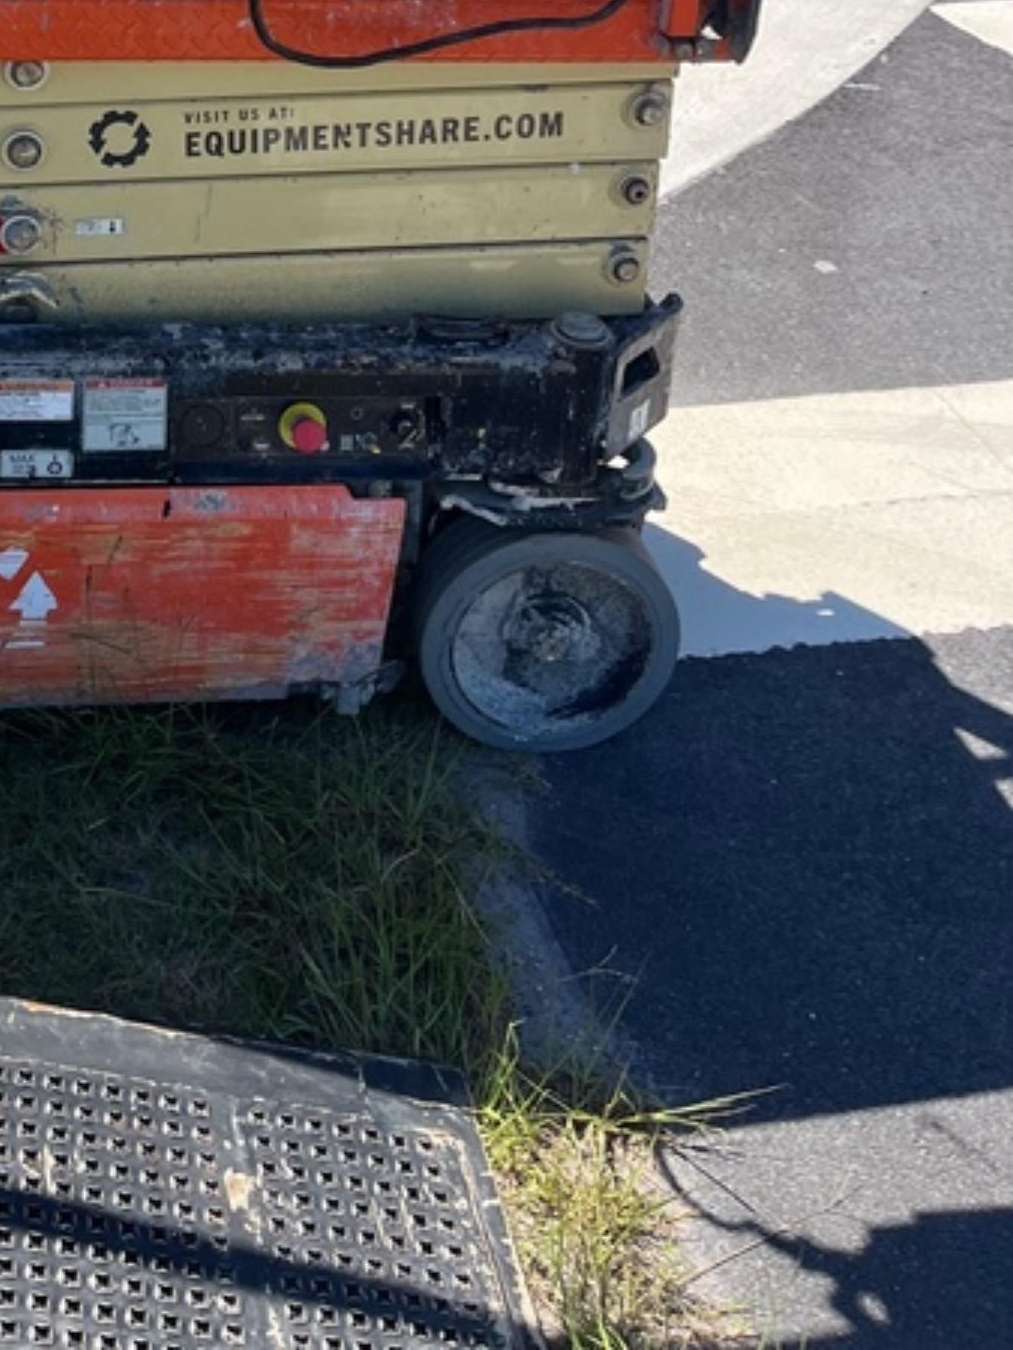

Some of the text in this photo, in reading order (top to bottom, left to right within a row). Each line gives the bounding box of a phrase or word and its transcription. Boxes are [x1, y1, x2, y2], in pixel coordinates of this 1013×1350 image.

[184, 107, 295, 124] VISIT US AT:
[184, 111, 565, 159] EQUIPMENTSHARE.COM
